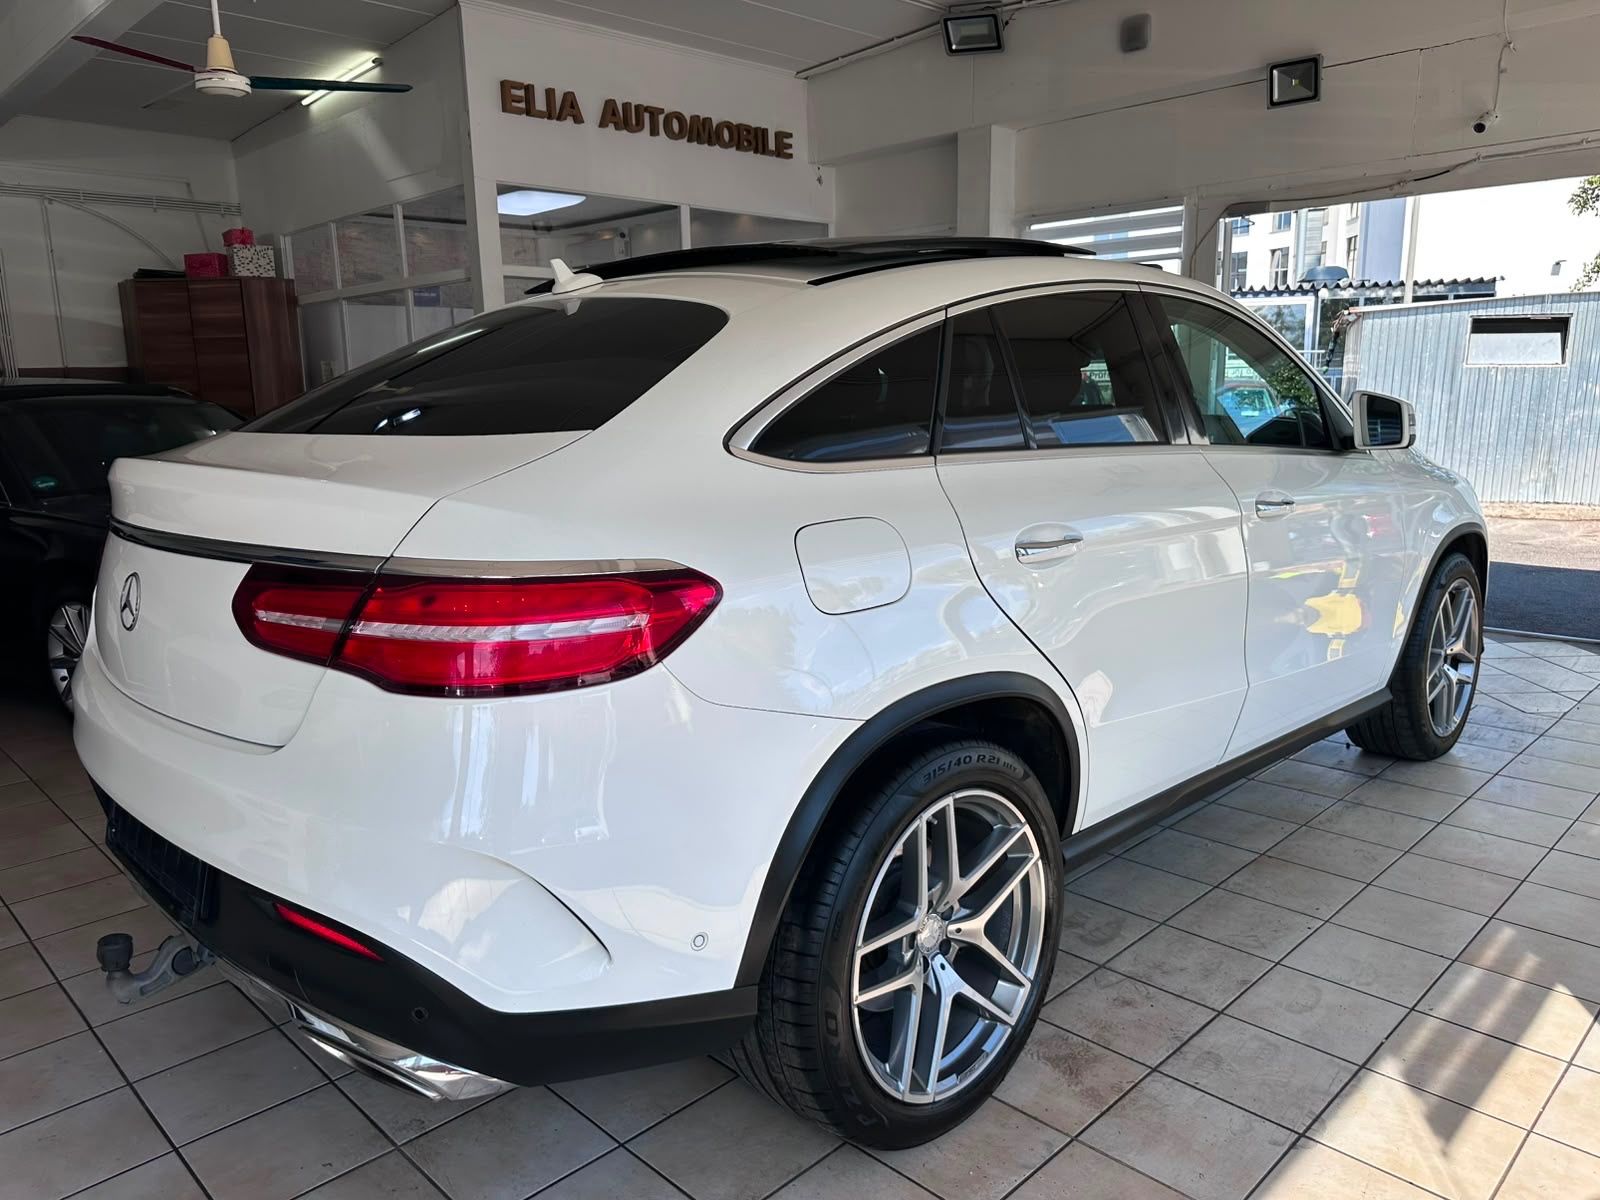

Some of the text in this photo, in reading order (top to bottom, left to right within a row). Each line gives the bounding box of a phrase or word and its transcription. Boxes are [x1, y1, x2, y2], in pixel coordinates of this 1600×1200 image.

[500, 79, 793, 159] ELIA AUTOMOBILE
[921, 755, 972, 785] 315/40
[976, 754, 1000, 765] R21
